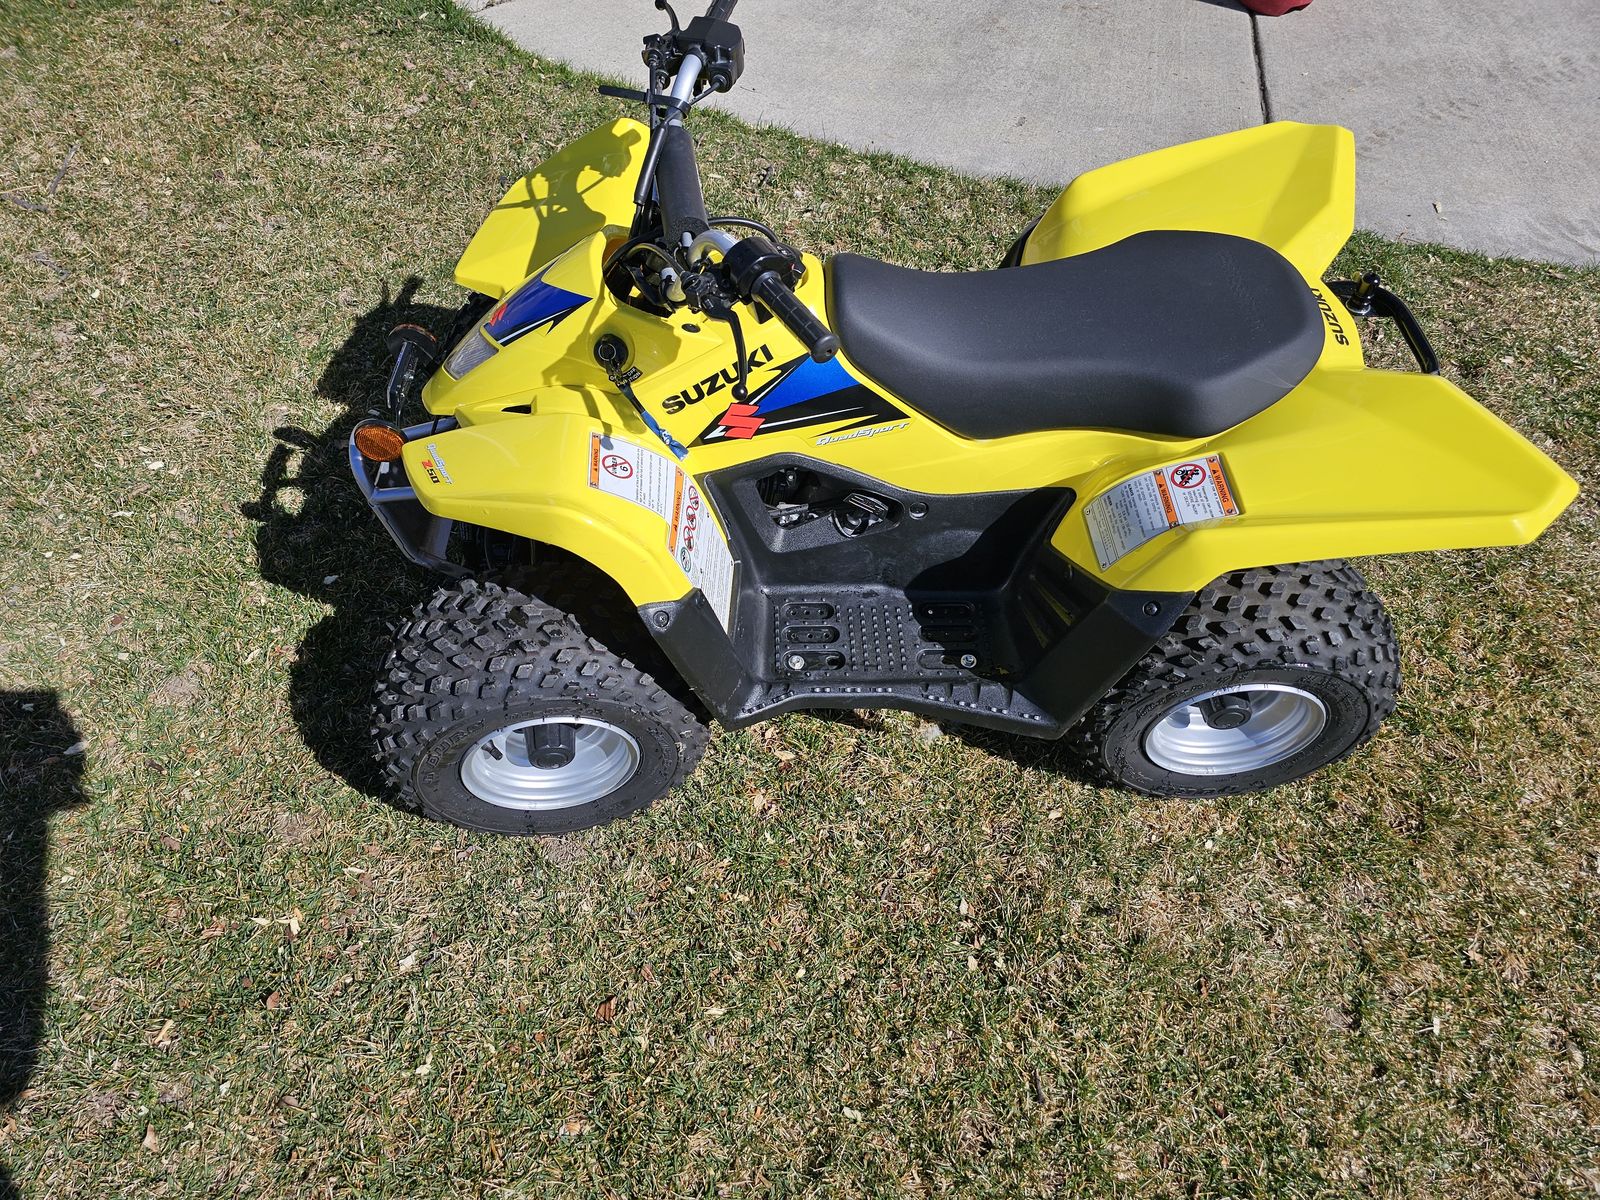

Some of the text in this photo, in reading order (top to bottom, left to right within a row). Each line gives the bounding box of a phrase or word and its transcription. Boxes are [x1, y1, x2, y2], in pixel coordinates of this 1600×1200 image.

[661, 343, 774, 415] SUZUKI
[815, 419, 910, 447] QuadSport
[1159, 488, 1172, 513] WARNING
[1214, 474, 1229, 502] WARNING
